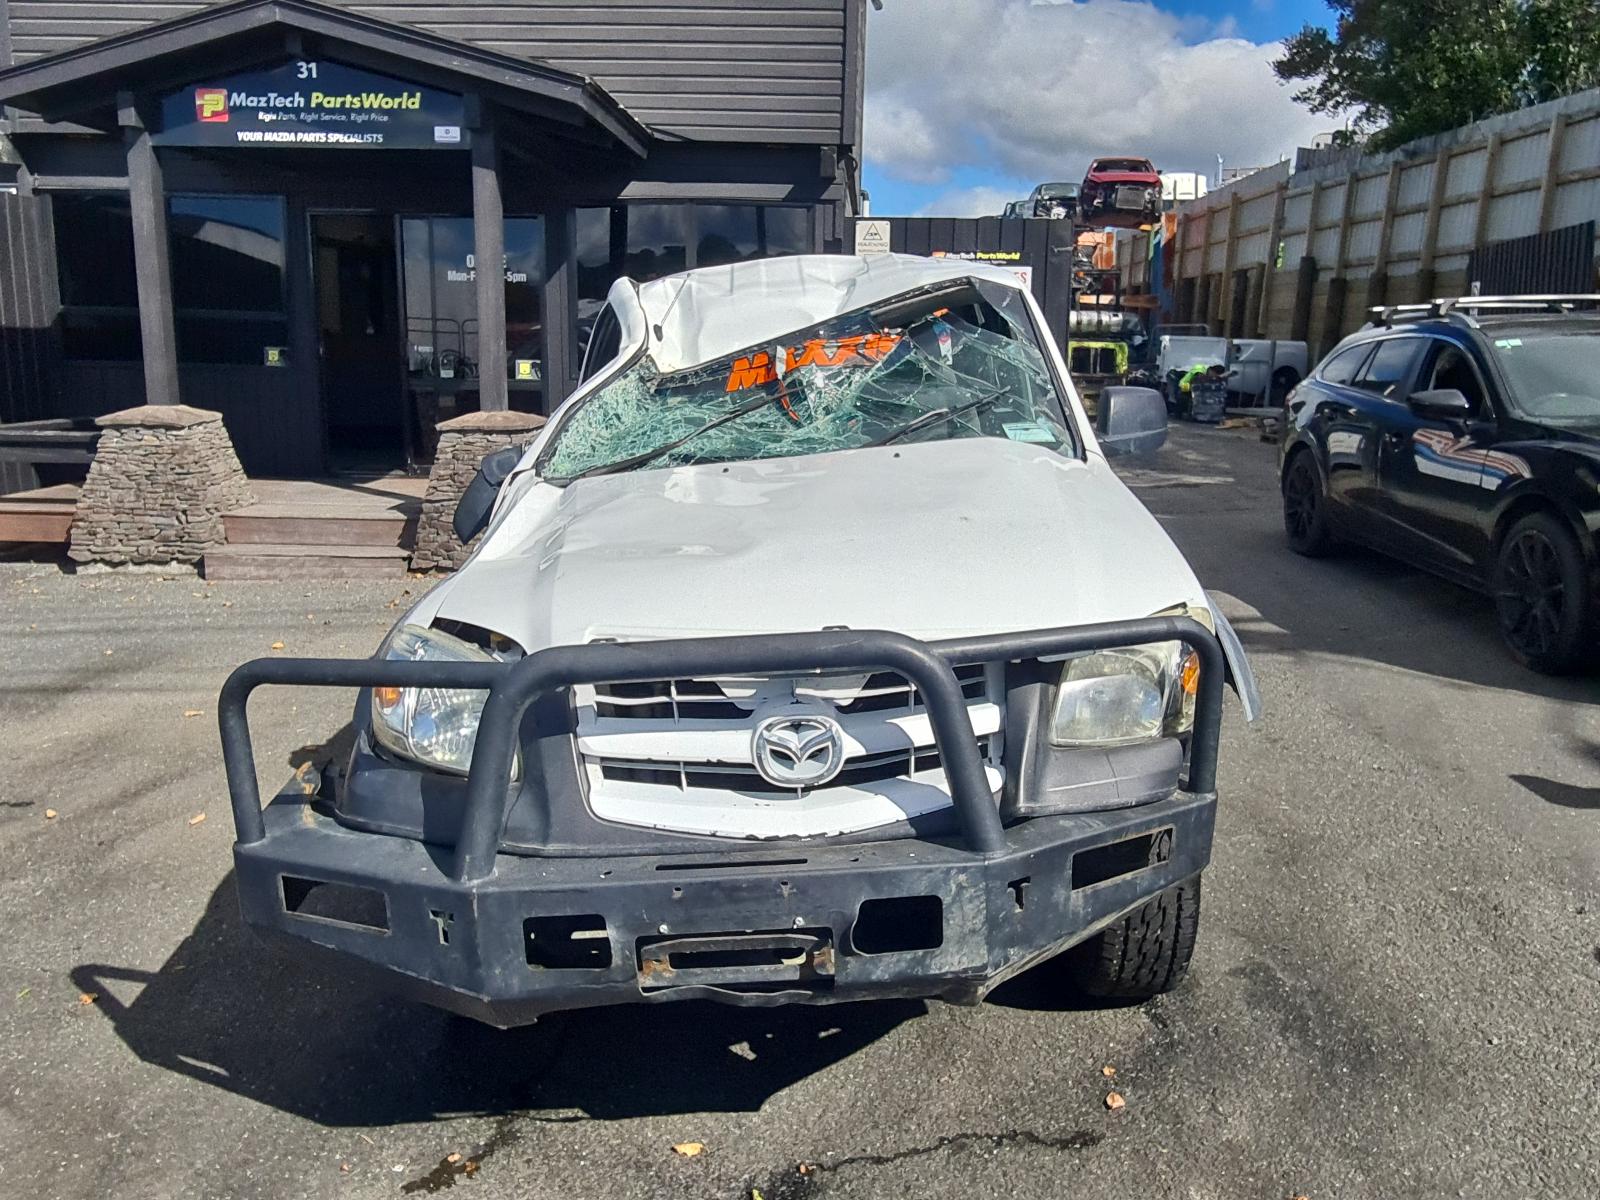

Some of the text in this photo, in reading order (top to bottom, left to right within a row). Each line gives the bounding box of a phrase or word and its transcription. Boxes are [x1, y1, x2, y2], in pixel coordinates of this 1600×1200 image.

[296, 62, 317, 79] 31
[229, 91, 421, 109] MazTech PartsWorld
[258, 111, 277, 122] Right
[300, 112, 319, 122] Right
[350, 113, 369, 123] Right
[370, 113, 389, 122] Price
[236, 131, 383, 143] YOUR MAZDA PARTS SPECIALISTS
